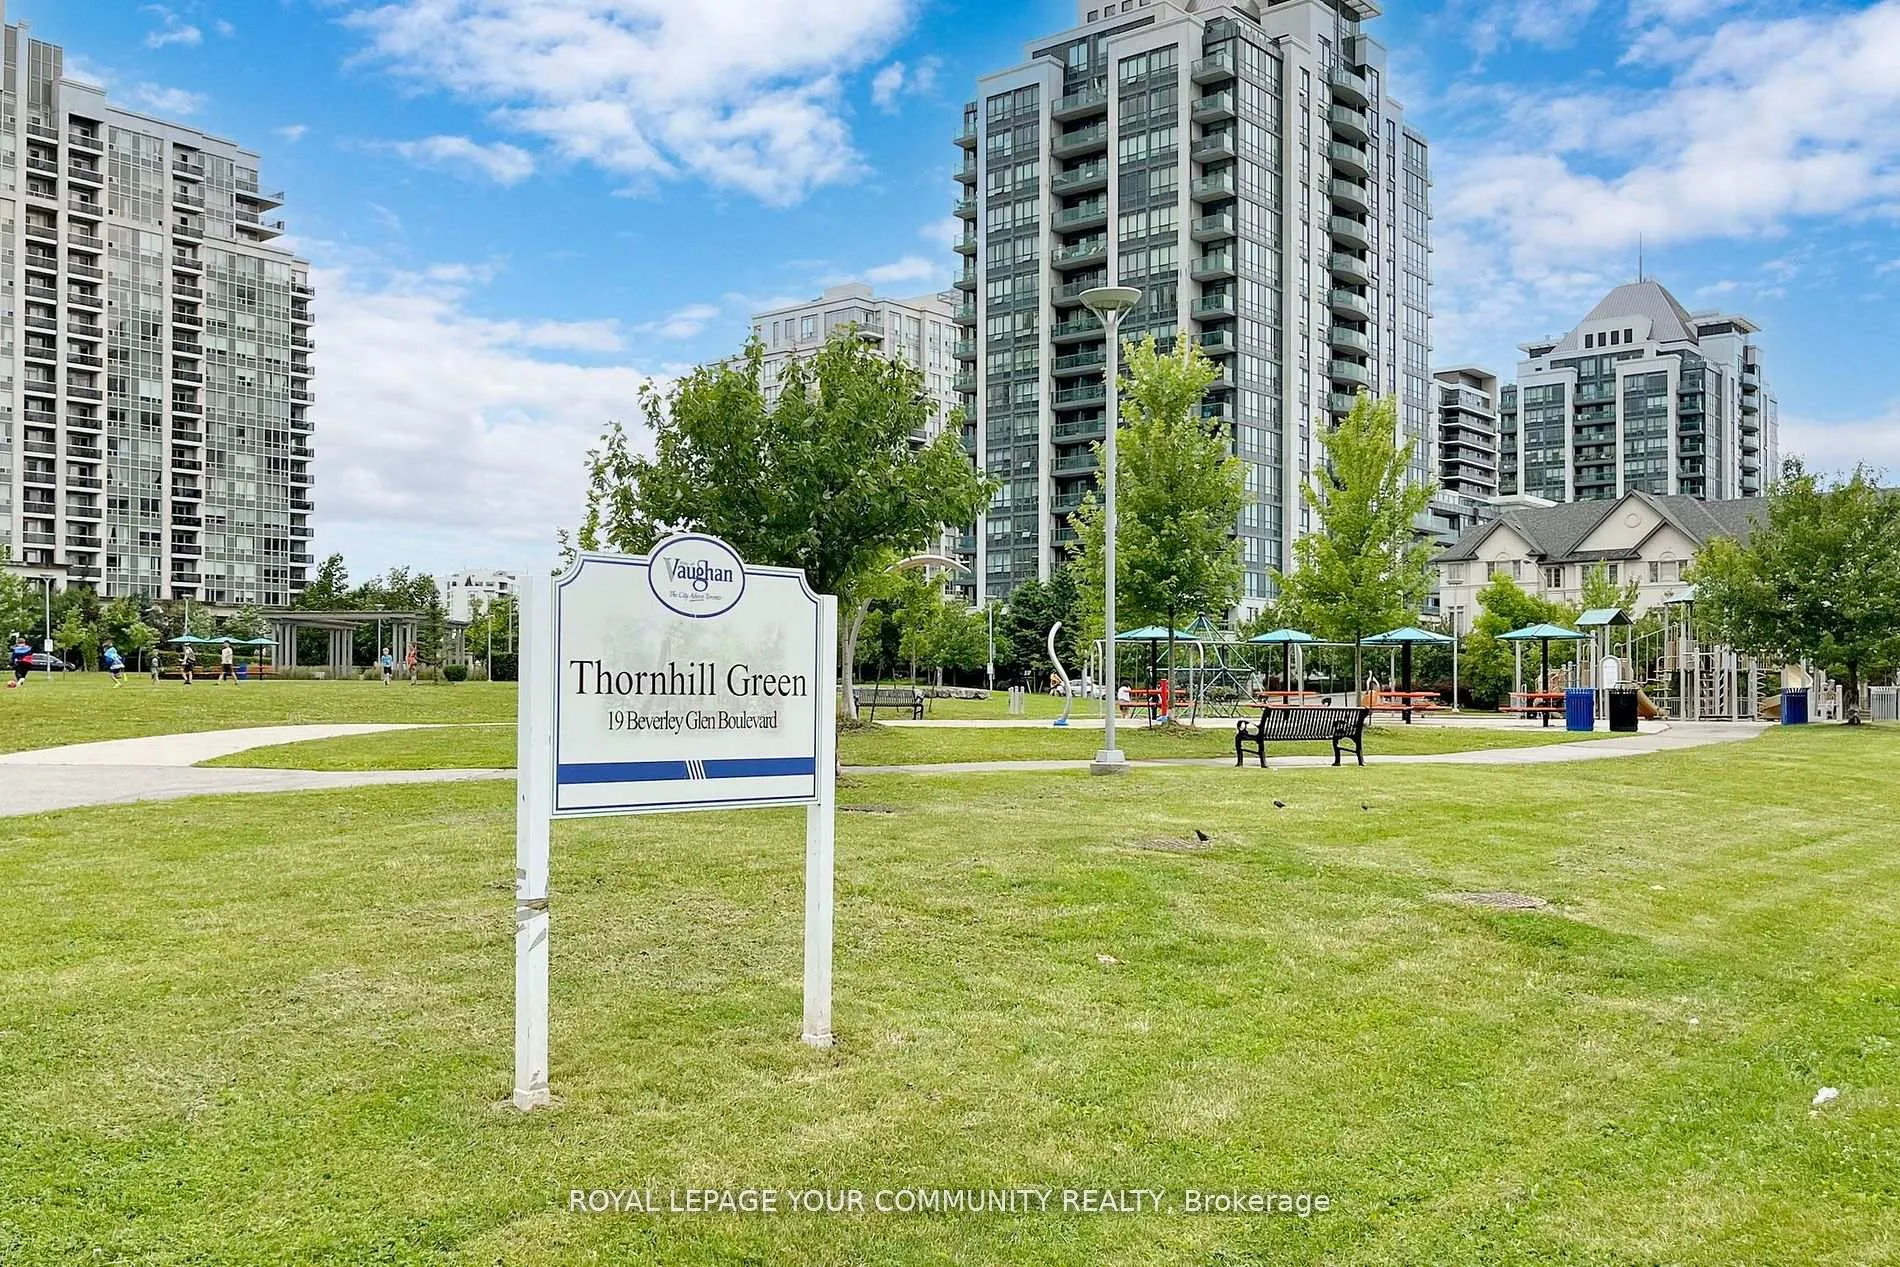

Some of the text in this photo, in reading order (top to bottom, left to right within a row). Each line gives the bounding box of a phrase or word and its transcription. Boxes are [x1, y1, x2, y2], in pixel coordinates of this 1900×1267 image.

[663, 557, 733, 592] Vaughan
[569, 659, 808, 697] Thornhill Green
[608, 710, 777, 735] 19 Beverley Glen Boulevard
